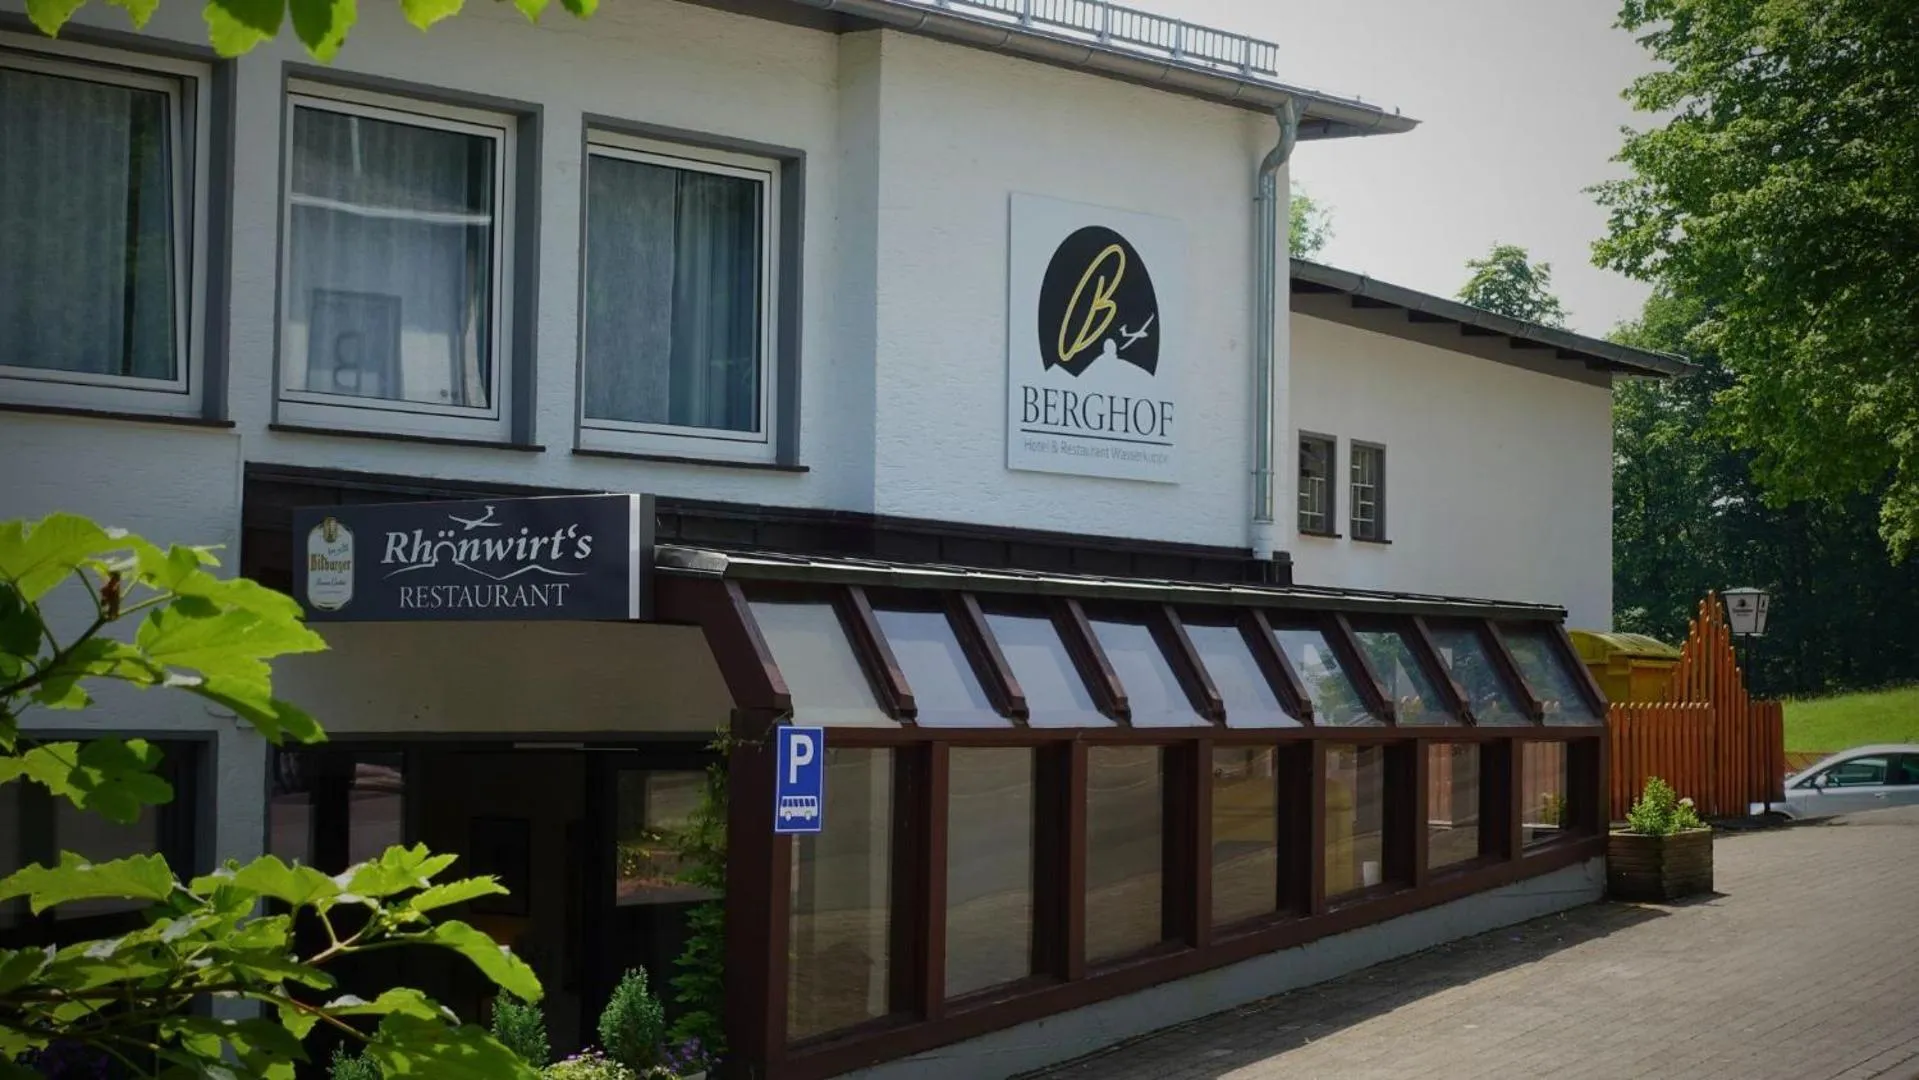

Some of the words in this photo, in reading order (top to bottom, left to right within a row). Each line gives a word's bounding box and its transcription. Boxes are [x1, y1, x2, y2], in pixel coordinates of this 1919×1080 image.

[1021, 385, 1174, 437] BERGHOF
[399, 582, 570, 609] RESTAURANT
[789, 734, 814, 784] P
